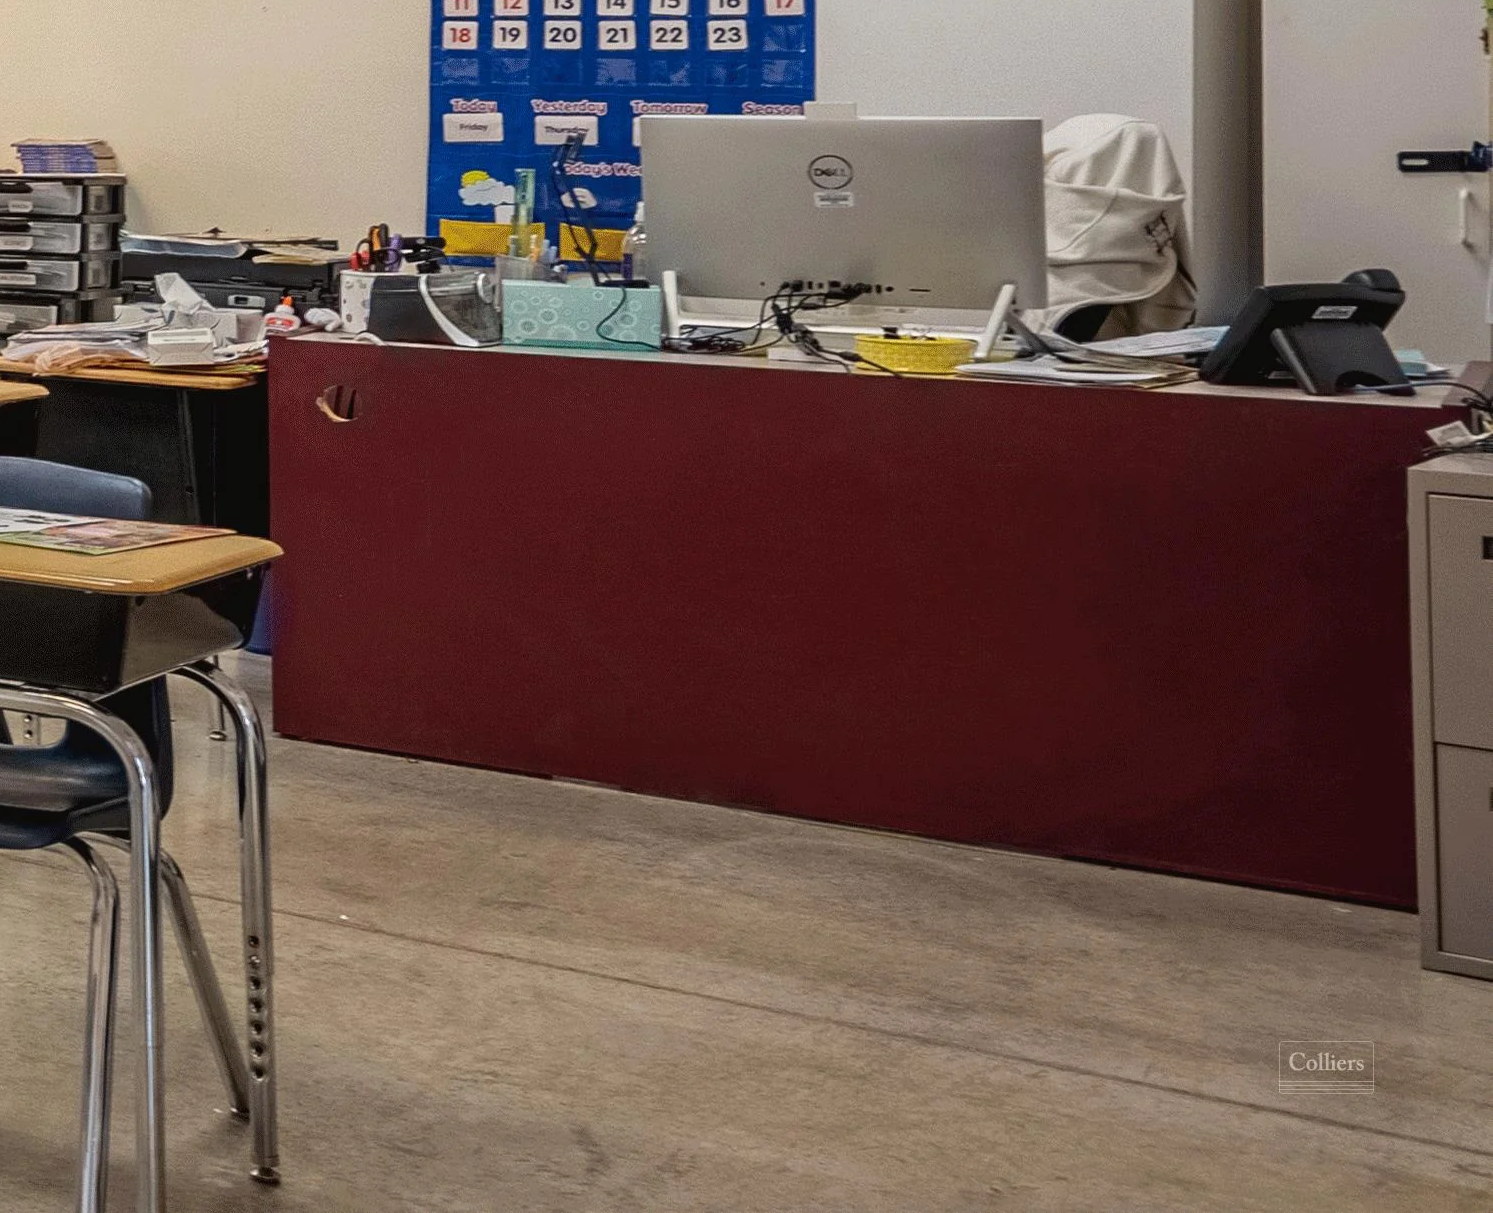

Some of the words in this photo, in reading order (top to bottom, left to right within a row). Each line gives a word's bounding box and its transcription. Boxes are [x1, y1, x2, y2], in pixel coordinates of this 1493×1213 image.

[450, 28, 470, 42] 18
[499, 27, 520, 41] 19
[549, 27, 576, 42] 20
[606, 28, 627, 43] 21
[655, 27, 683, 42] 22
[713, 27, 741, 43] 23
[452, 99, 497, 113] Today
[531, 100, 607, 114] Yesterday
[631, 101, 708, 114] Tomorrow
[743, 102, 803, 115] Season
[459, 123, 488, 132] Friday
[564, 164, 611, 176] oday's
